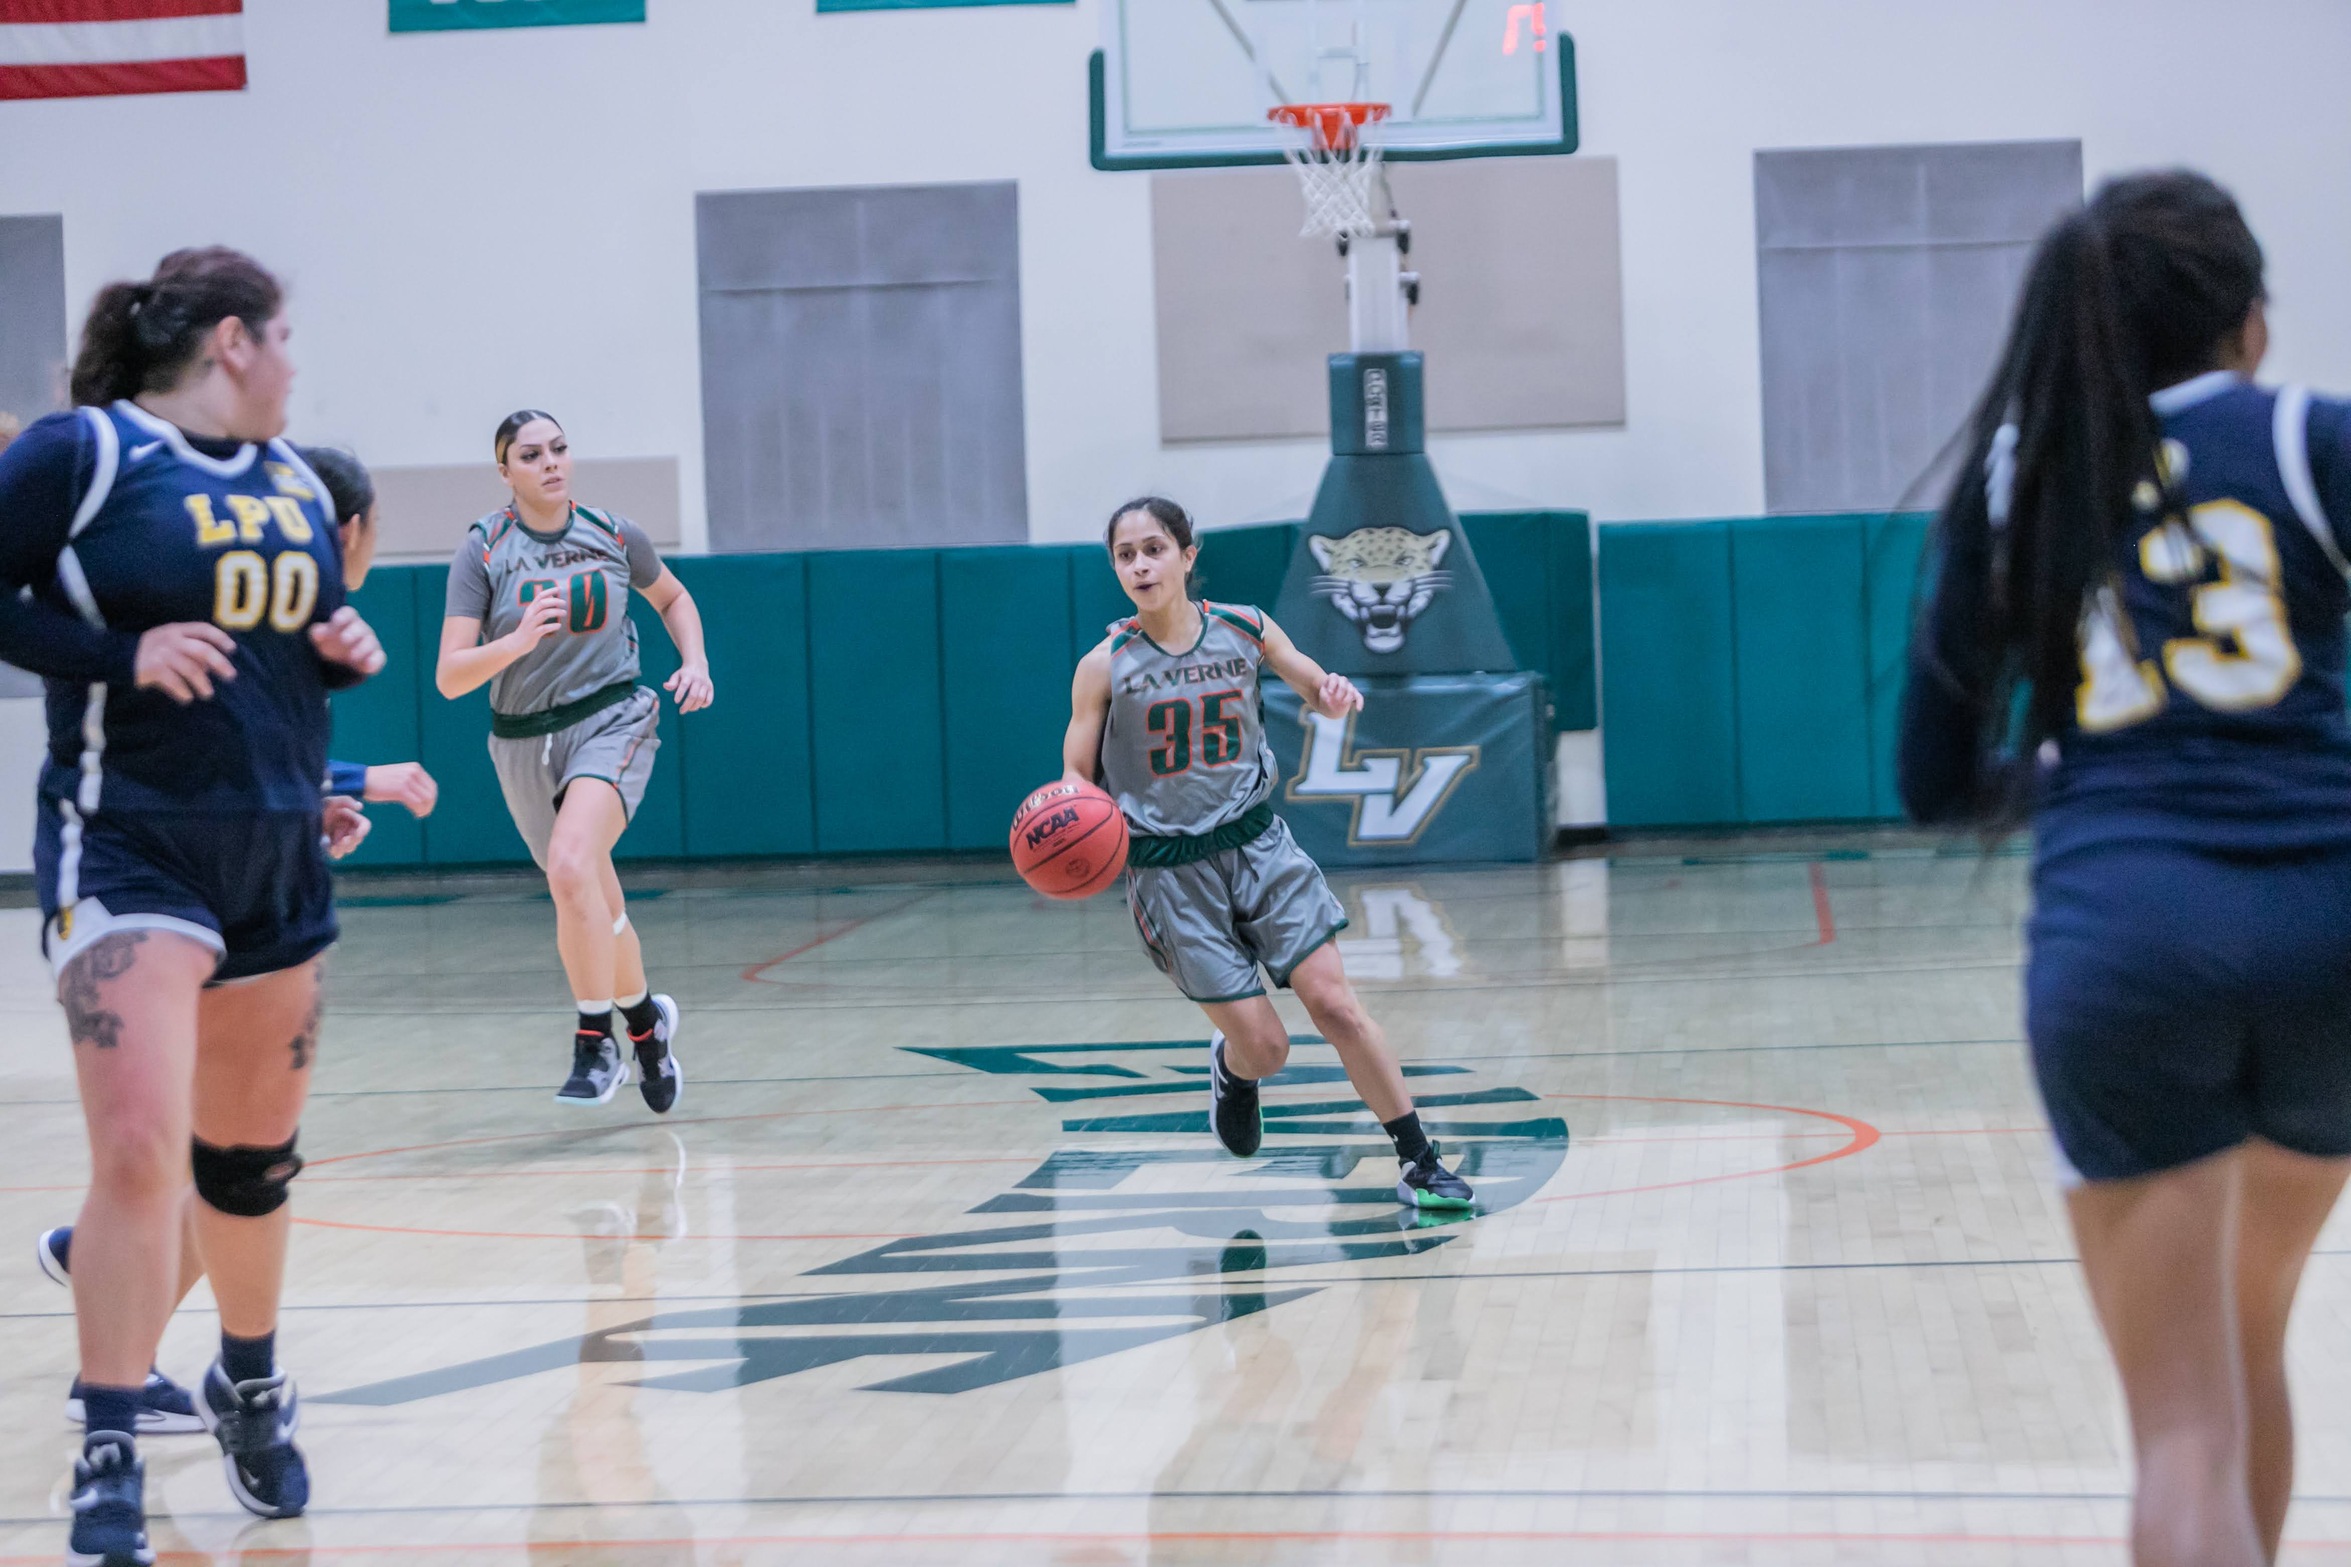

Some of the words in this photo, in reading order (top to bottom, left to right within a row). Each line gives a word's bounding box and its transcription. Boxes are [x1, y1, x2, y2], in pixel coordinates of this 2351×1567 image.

[213, 550, 319, 633] 00
[506, 556, 532, 574] LA
[1123, 672, 1162, 694] LA
[1163, 657, 1249, 688] VERNE
[1147, 689, 1244, 779] 35
[1285, 702, 1480, 846] LV
[1026, 807, 1080, 850] NCAA
